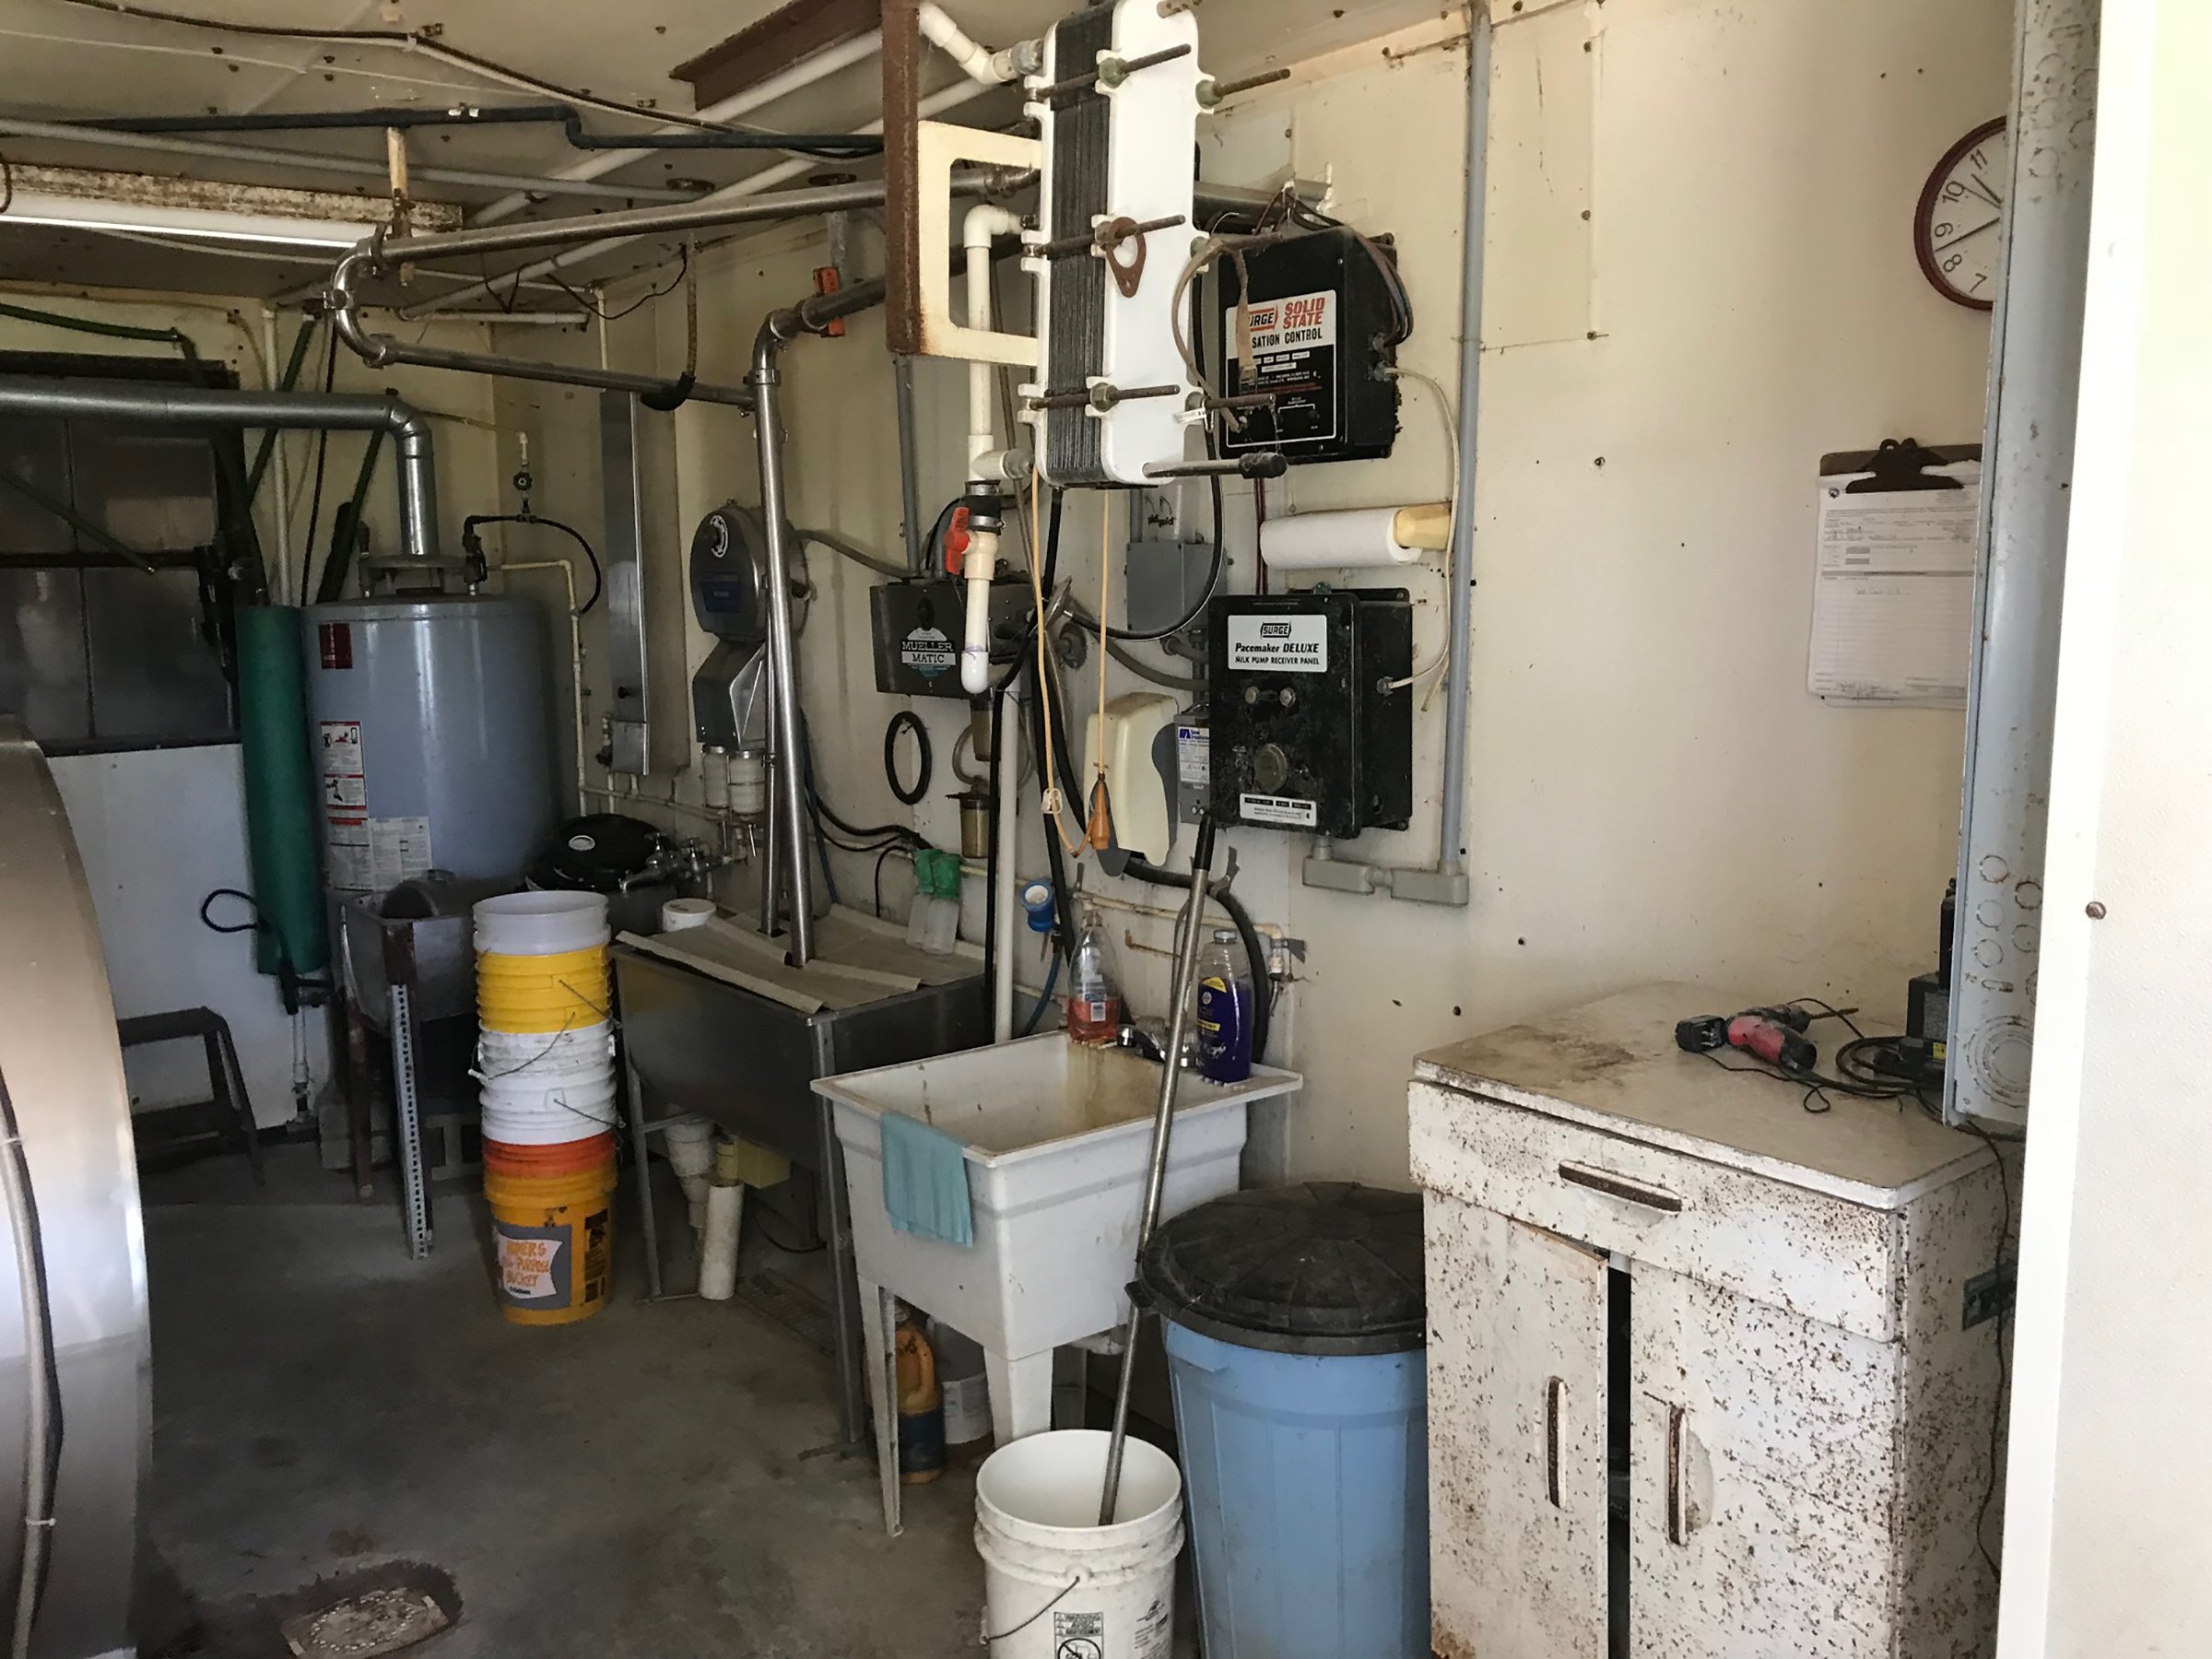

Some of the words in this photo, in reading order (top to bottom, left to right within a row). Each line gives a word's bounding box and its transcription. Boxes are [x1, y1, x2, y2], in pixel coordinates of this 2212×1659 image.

[1971, 148, 1988, 170] 11
[1942, 181, 1965, 204] 10
[1934, 222, 1953, 238] 9
[1943, 253, 1962, 272] 8
[1970, 273, 1988, 293] 7
[1284, 297, 1325, 316] SOLID
[1249, 312, 1275, 327] URGE
[1282, 311, 1324, 329] STATE
[1252, 334, 1280, 348] SATION
[1285, 328, 1323, 344] CONTROL
[1263, 626, 1288, 635] SURGE
[901, 641, 954, 652] MUELLER
[1235, 642, 1280, 653] Pacemaker
[1282, 642, 1319, 653] DELUXE
[912, 653, 945, 664] MATIC
[1235, 655, 1250, 664] MILK
[1271, 656, 1299, 665] RECEIVER
